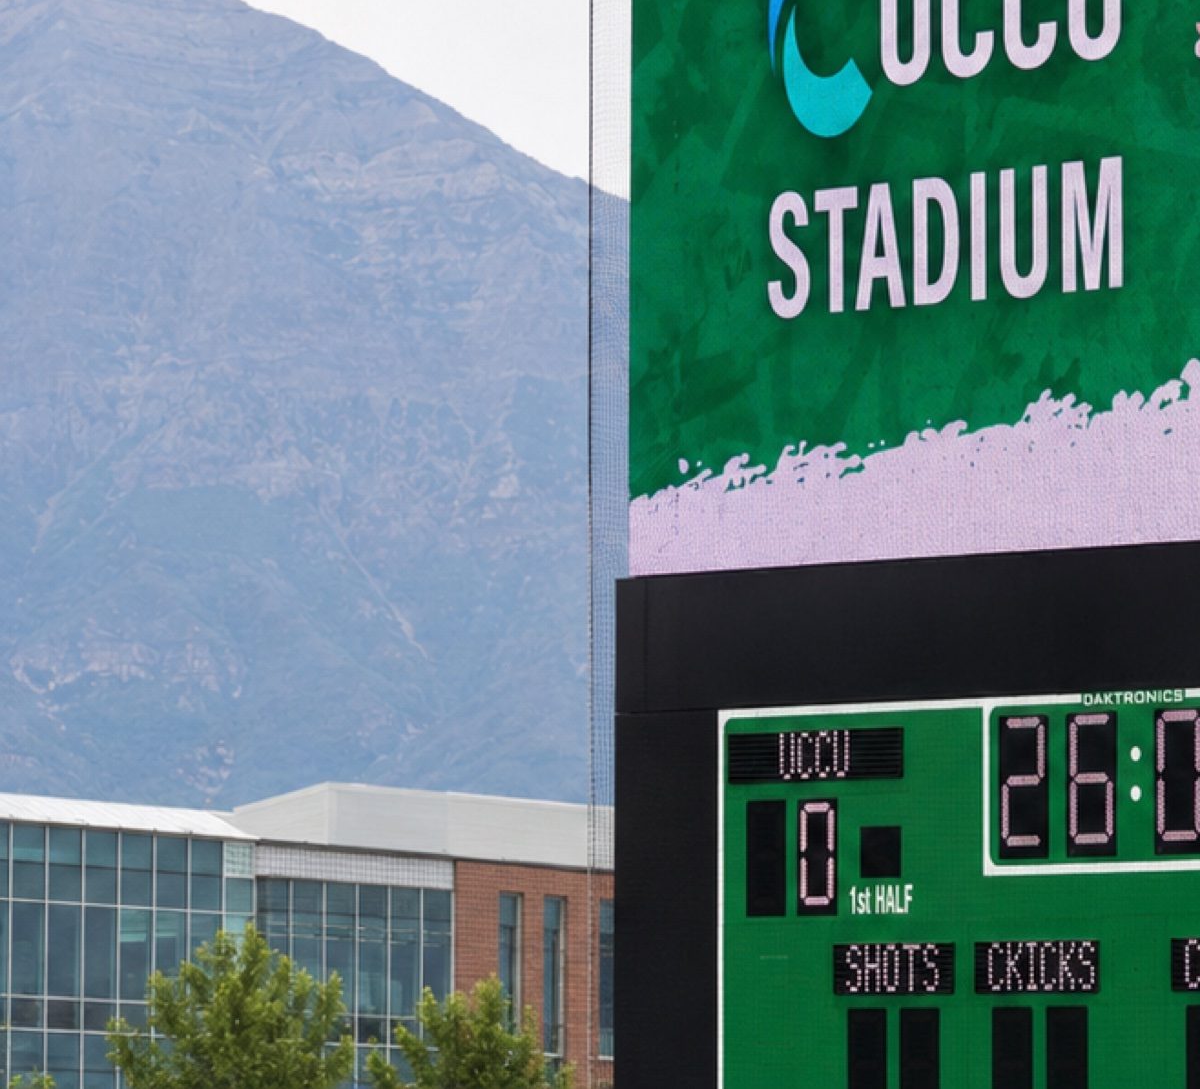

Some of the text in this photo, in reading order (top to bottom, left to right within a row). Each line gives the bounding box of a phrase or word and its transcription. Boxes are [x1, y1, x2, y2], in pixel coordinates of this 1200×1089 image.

[767, 156, 1123, 319] STADIUM
[1083, 689, 1184, 706] DAKTRONICS
[779, 729, 850, 779] UCCU
[799, 802, 835, 906] 0
[849, 884, 912, 914] 1st HALF
[844, 944, 940, 993] SHOTS
[987, 941, 1096, 991] CKICKS
